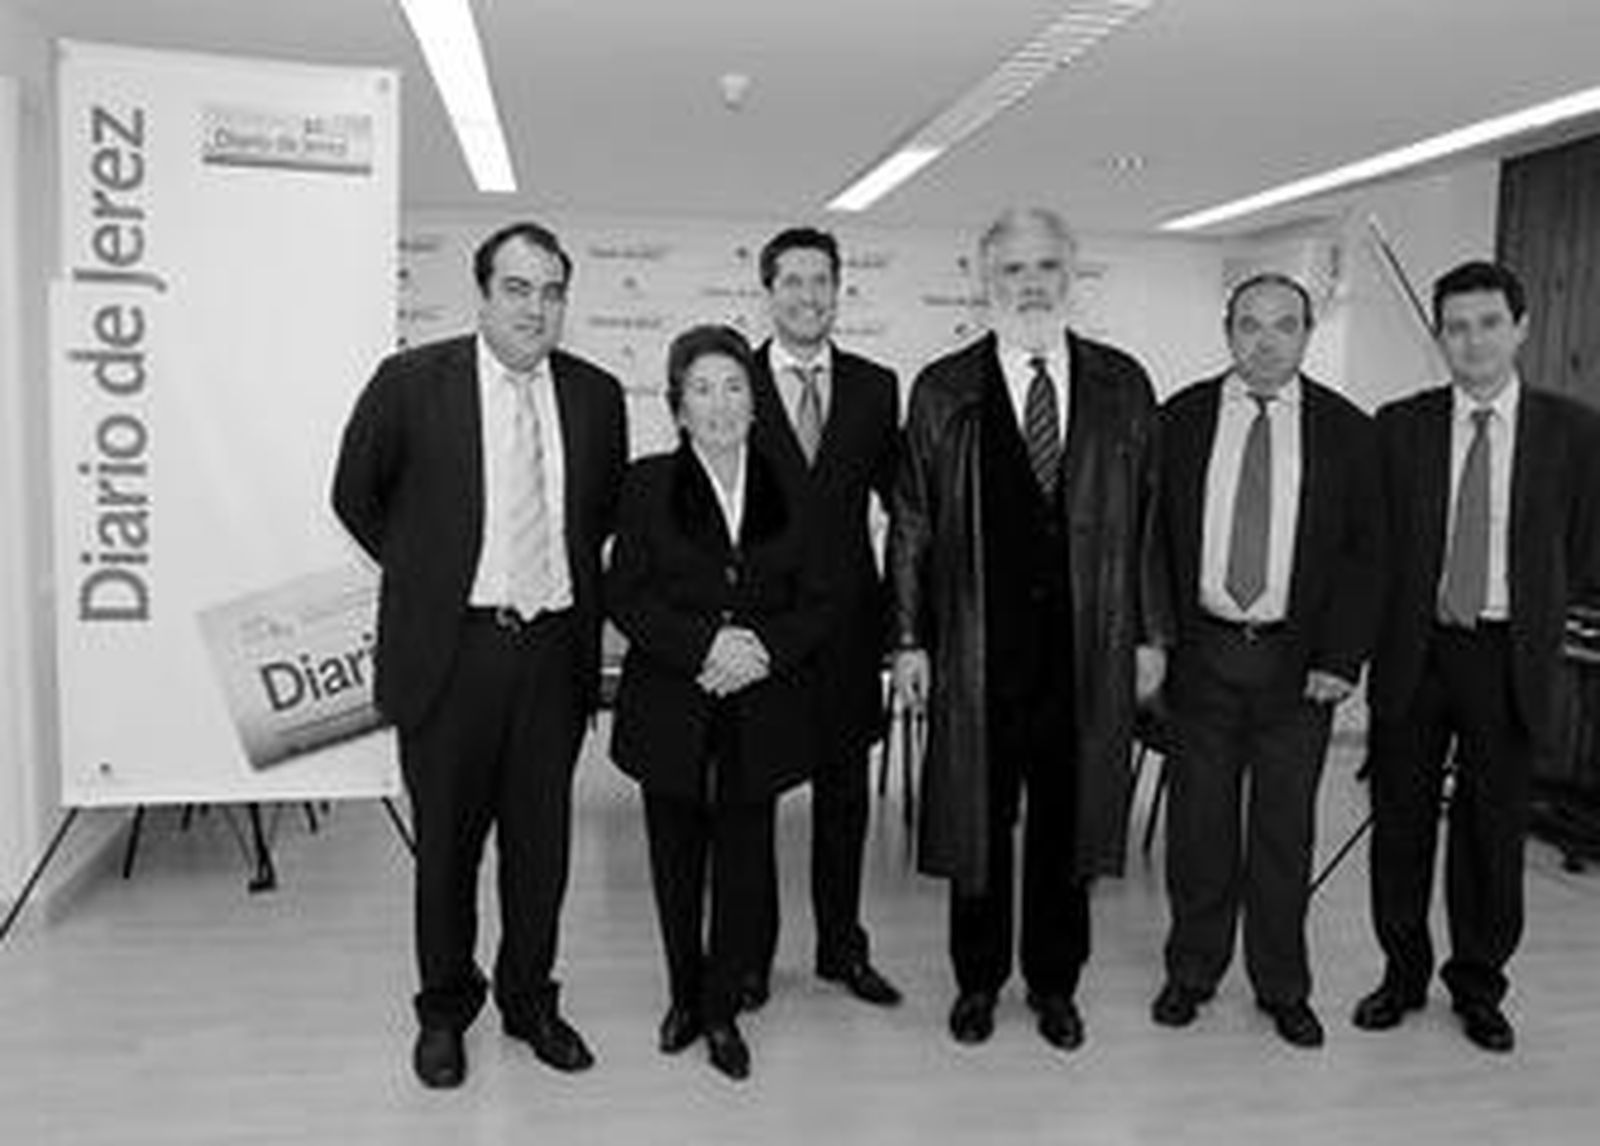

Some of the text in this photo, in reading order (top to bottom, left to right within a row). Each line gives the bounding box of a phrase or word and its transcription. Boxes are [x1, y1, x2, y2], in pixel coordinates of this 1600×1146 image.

[67, 106, 167, 622] Diario de Jerez
